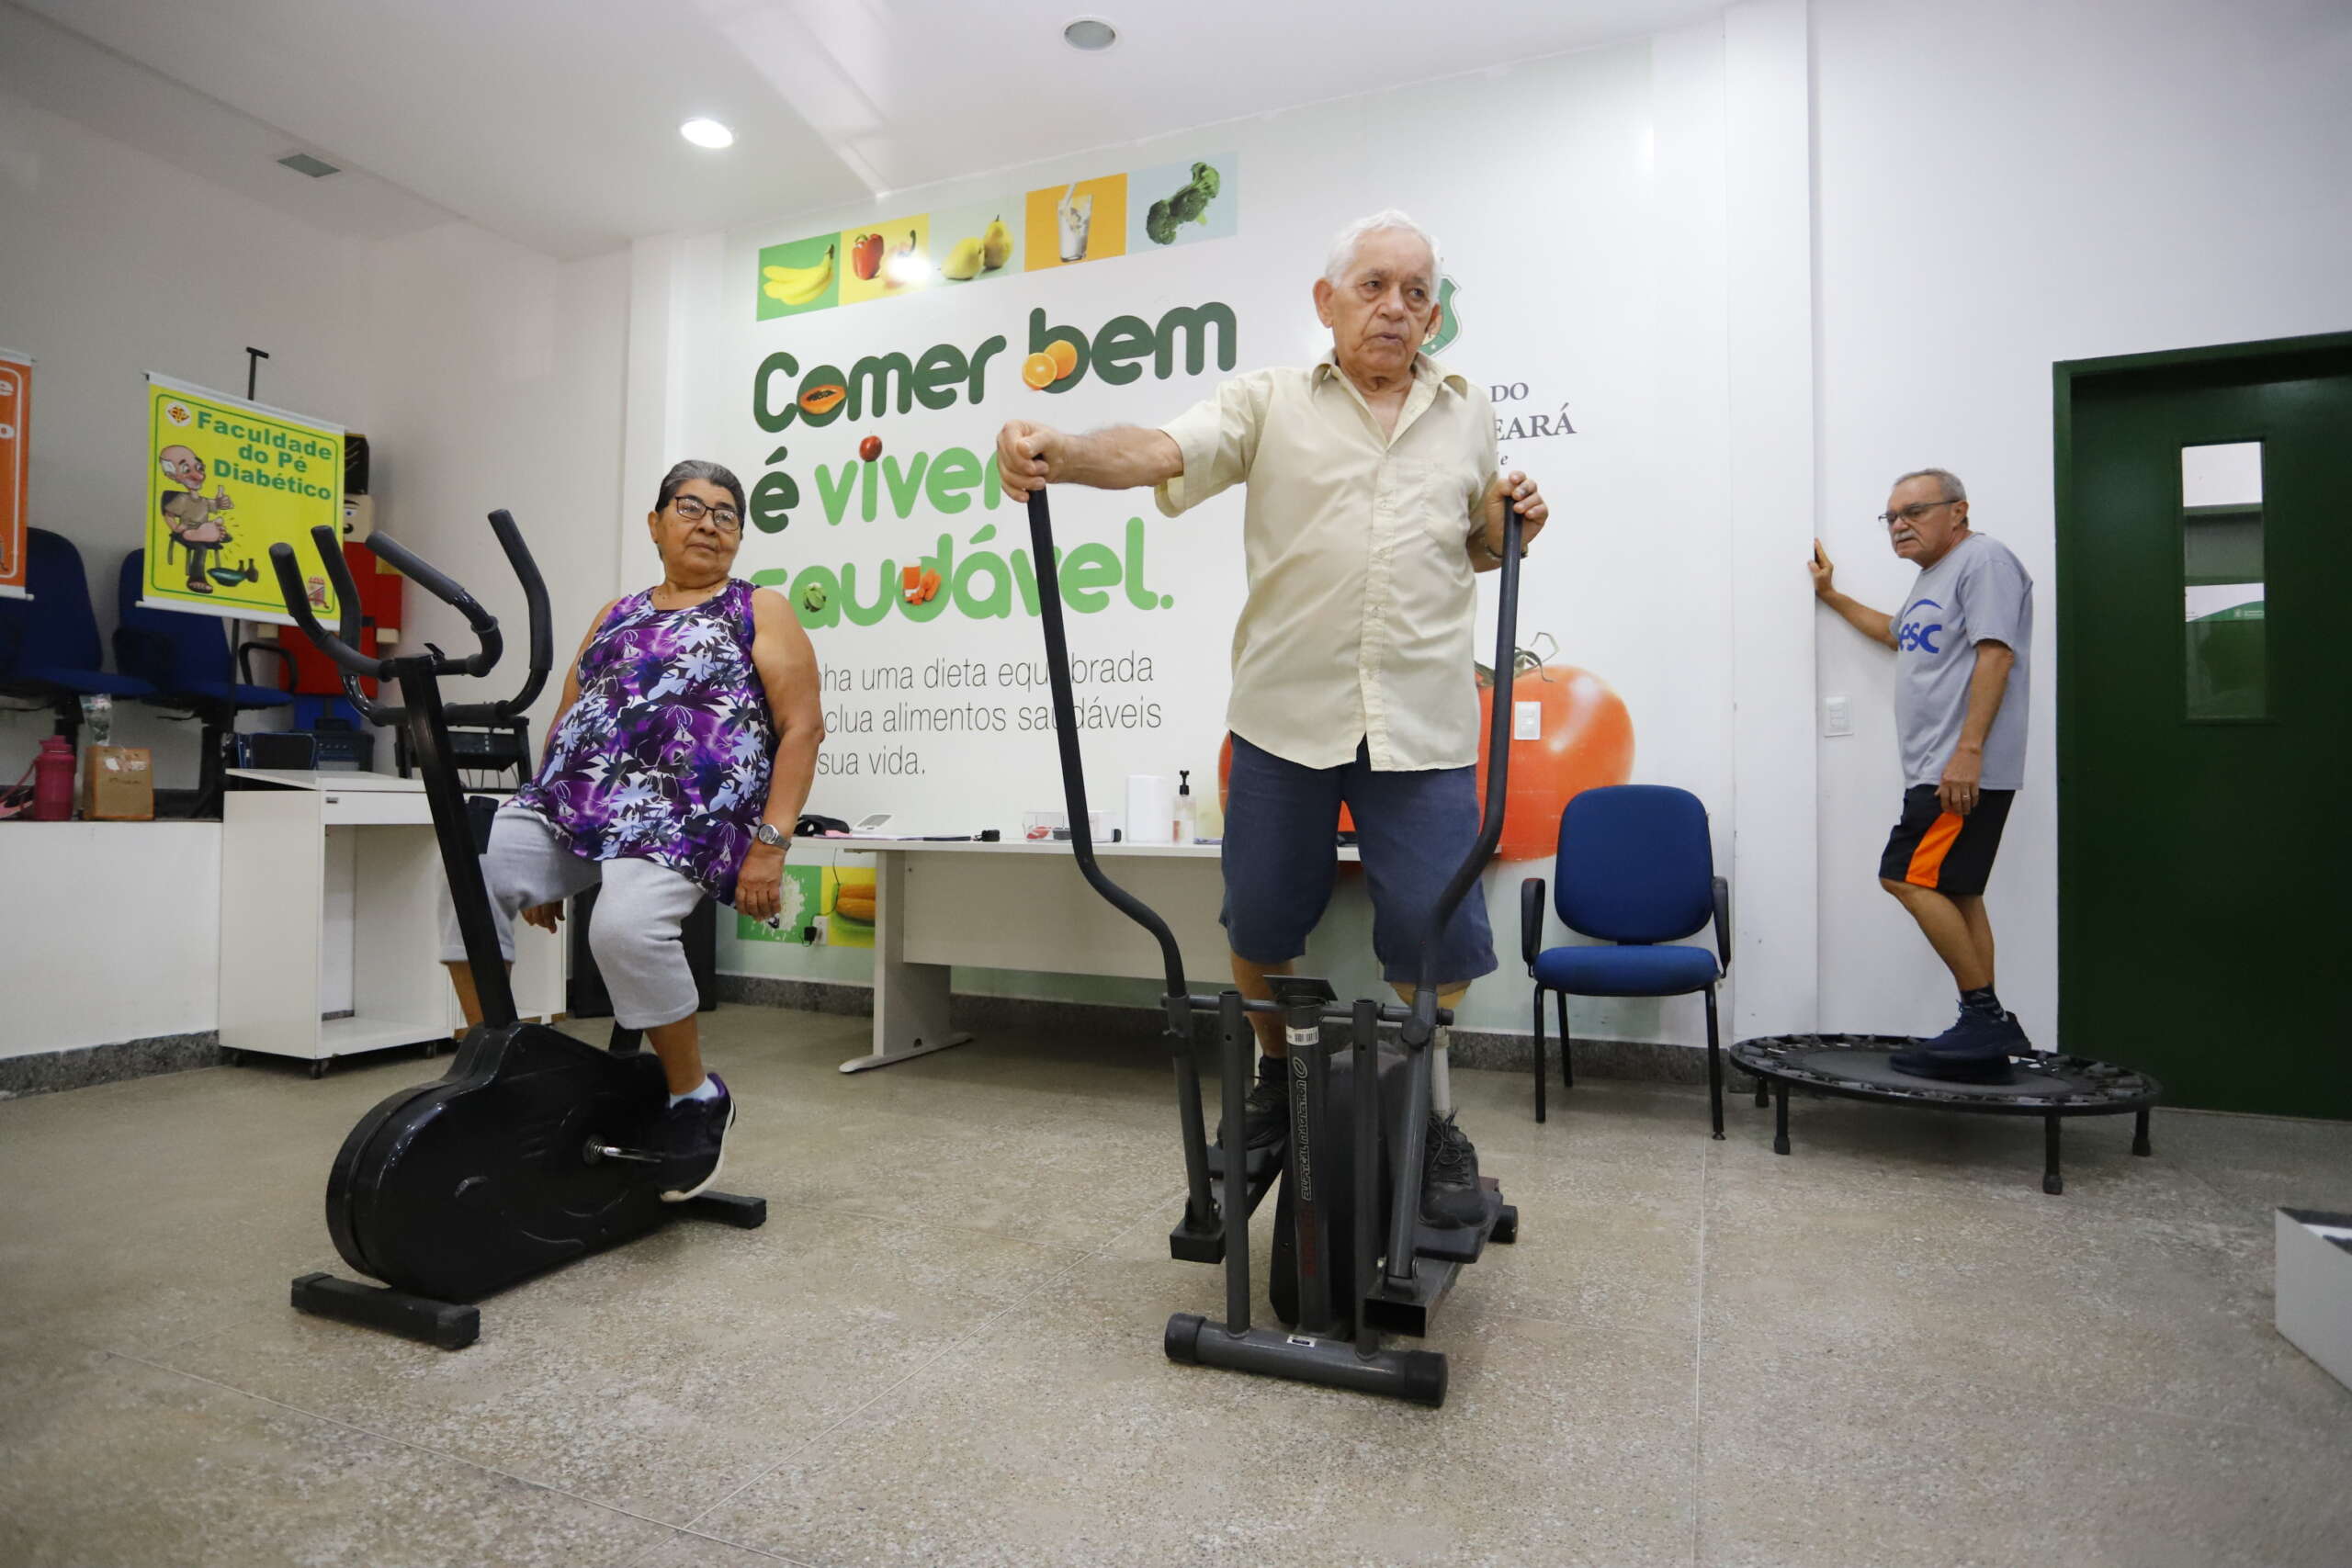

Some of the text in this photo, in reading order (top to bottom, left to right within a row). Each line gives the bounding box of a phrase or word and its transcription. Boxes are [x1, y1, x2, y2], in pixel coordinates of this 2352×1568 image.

[753, 301, 1237, 433] Comer bem
[1489, 382, 1529, 402] DO
[197, 412, 333, 460] Faculdade
[1495, 402, 1577, 441] EARÁ
[238, 444, 308, 472] do Pé
[214, 459, 332, 501] Diabético
[750, 446, 799, 534] é
[862, 666, 914, 691] uma
[923, 657, 987, 689] dieta
[998, 650, 1154, 694] equbrada
[824, 703, 874, 734] clua
[882, 701, 1006, 733] alimentos
[817, 744, 926, 775] sua vida.
